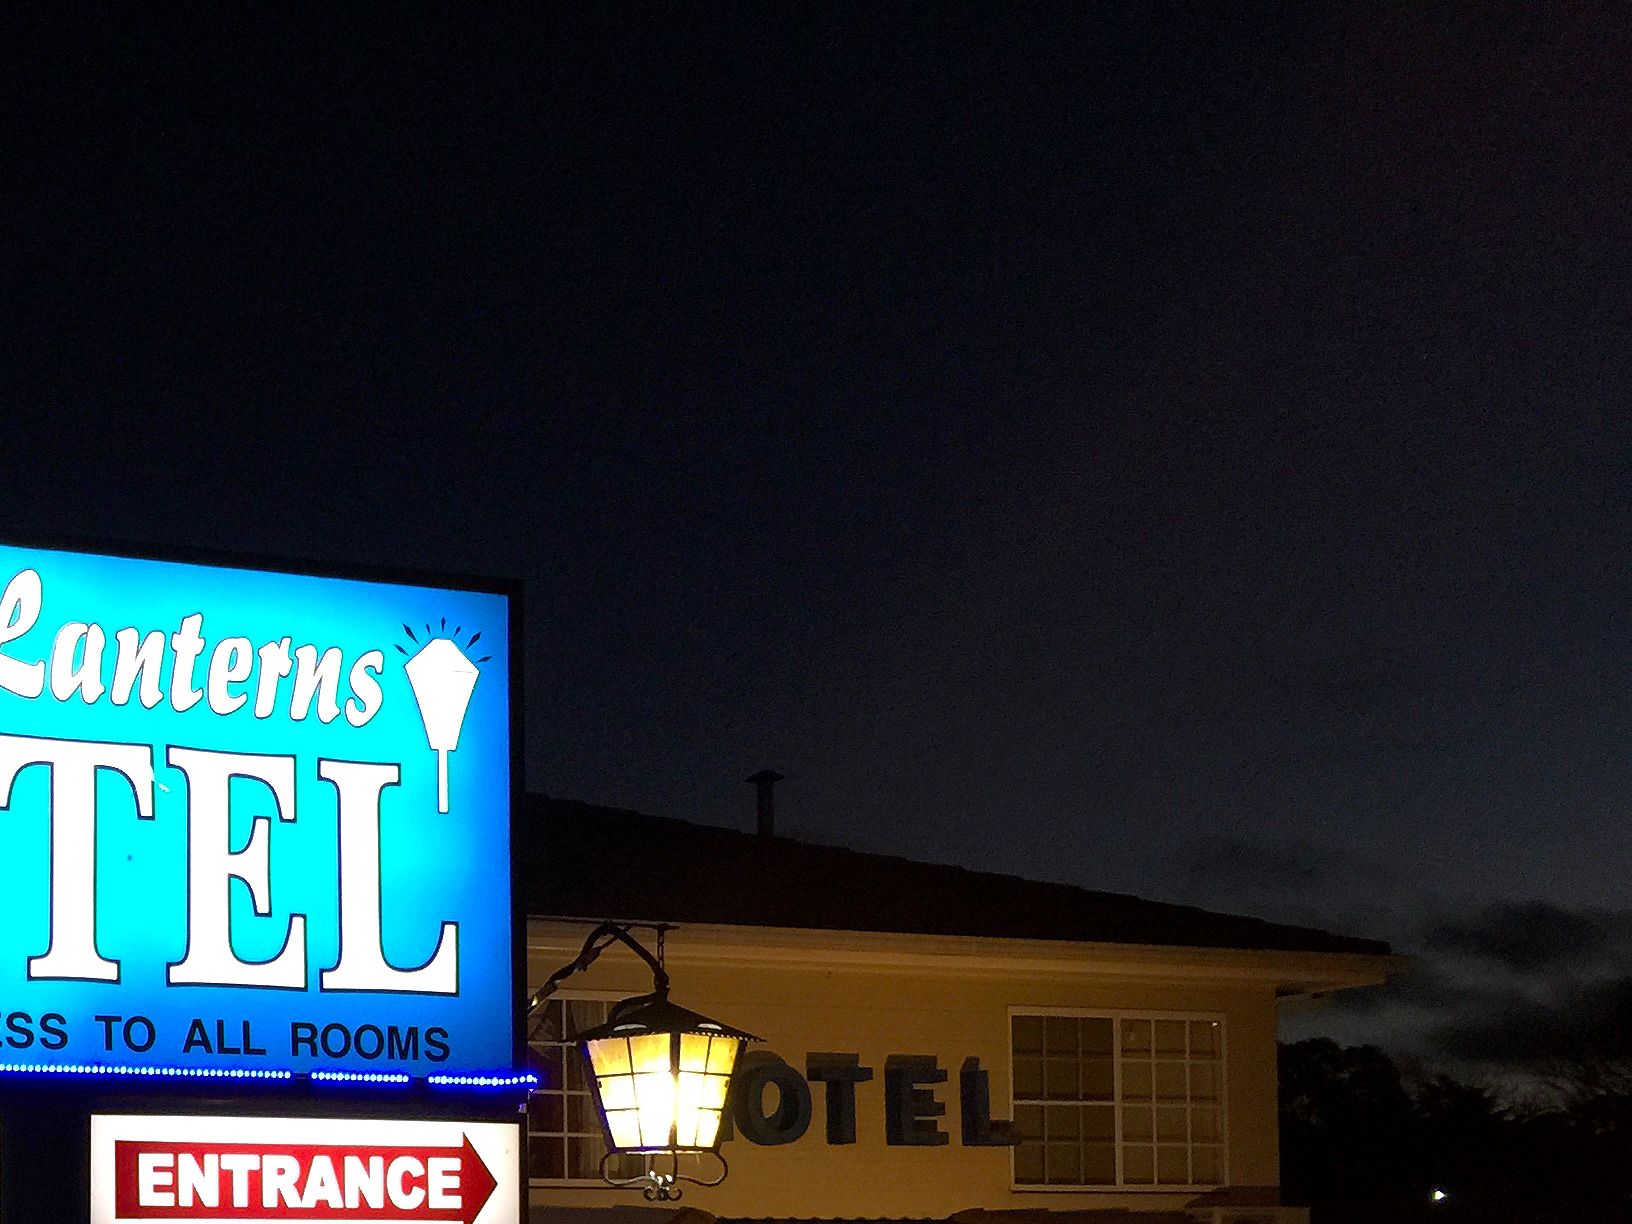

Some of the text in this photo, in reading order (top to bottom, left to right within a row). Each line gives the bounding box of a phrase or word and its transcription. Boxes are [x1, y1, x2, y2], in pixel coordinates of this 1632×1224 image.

[94, 1014, 157, 1055] TO
[182, 1017, 267, 1058] ALL
[289, 1020, 452, 1063] ROOMS
[721, 1049, 1022, 1147] OTEL
[137, 1152, 463, 1210] ENTRANCE
